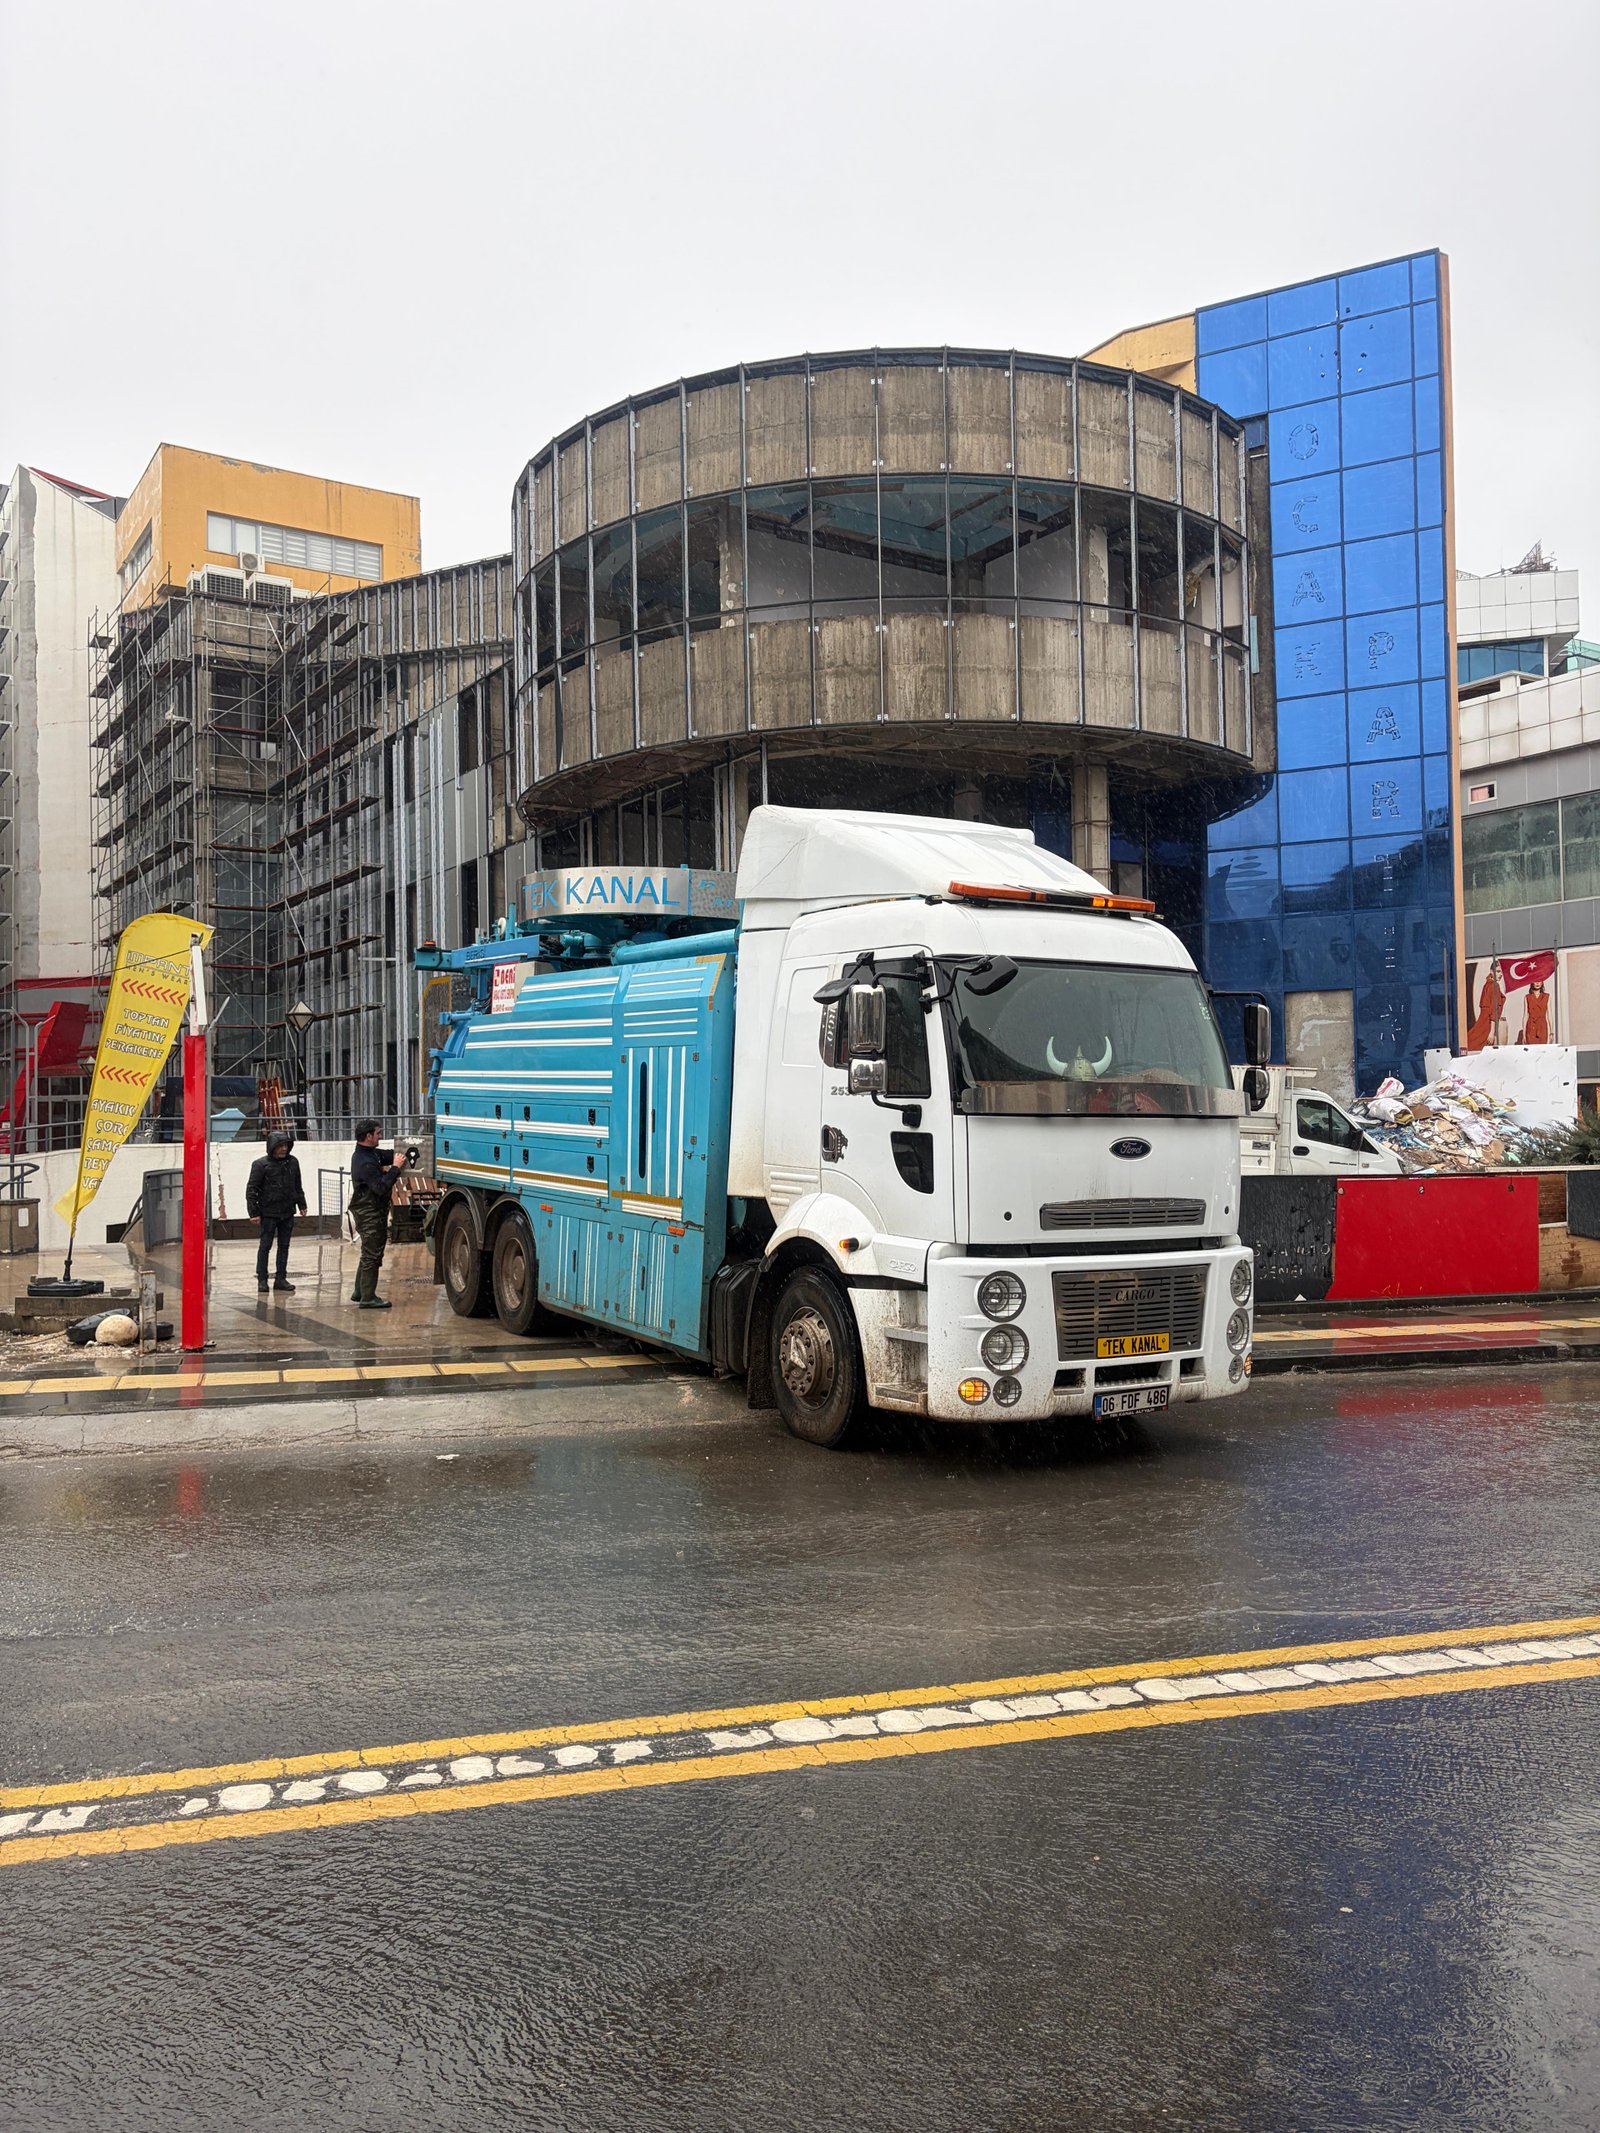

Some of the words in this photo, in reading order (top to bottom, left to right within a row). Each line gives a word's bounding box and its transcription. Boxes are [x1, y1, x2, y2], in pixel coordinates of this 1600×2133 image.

[522, 880, 558, 909] TEK
[566, 876, 681, 906] KANAL
[123, 1008, 170, 1028] TOPTAN
[1120, 1142, 1143, 1154] Ford
[1115, 1288, 1155, 1302] CARGO
[1106, 1339, 1126, 1355] TEK
[1131, 1335, 1162, 1353] KANAL
[1102, 1397, 1115, 1413] 06
[1121, 1392, 1141, 1410] FDF
[1147, 1389, 1167, 1406] 486
